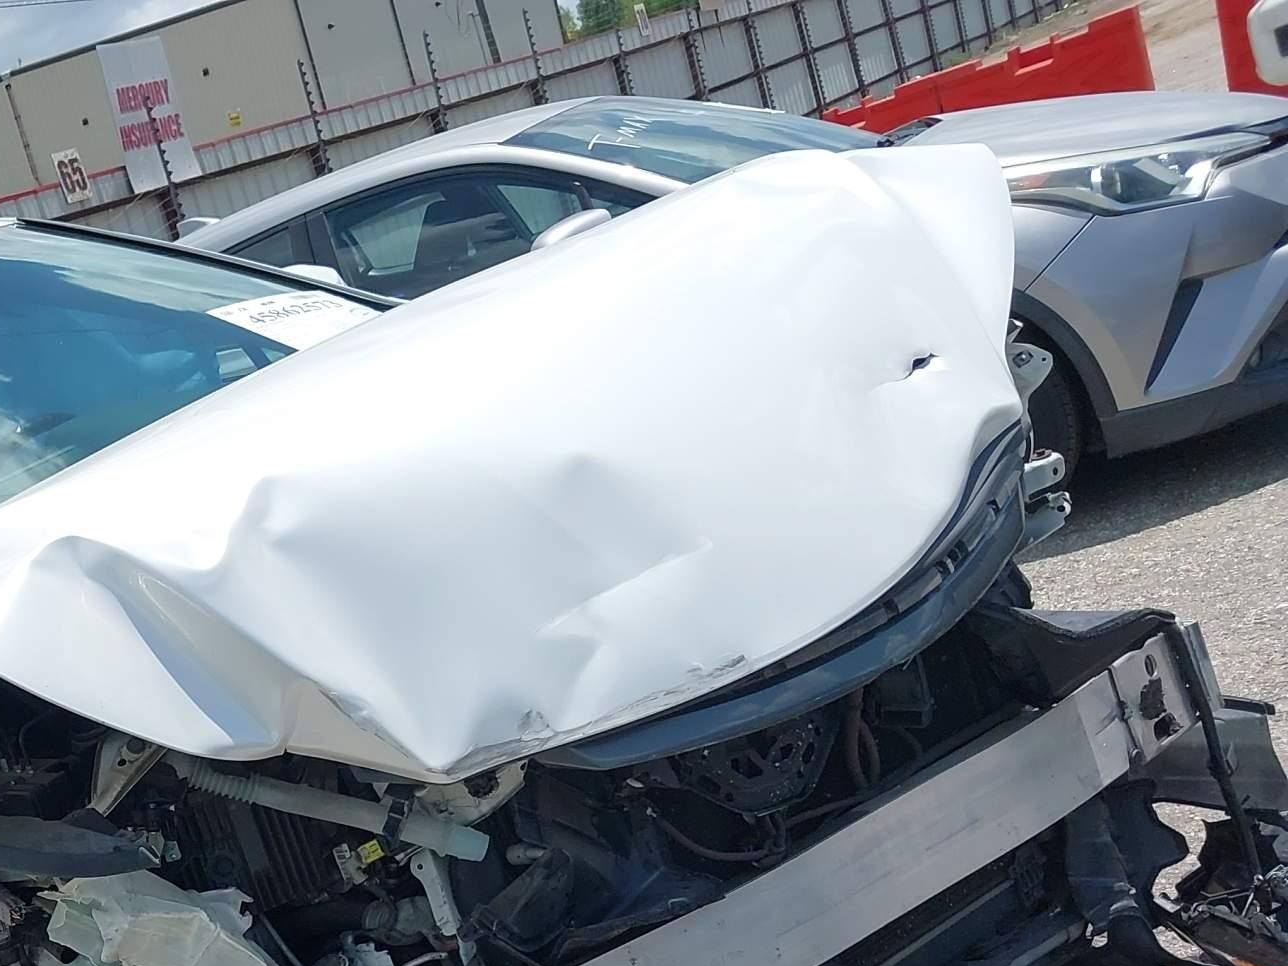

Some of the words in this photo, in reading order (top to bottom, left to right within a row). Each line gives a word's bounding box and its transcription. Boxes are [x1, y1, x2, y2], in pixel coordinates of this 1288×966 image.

[116, 79, 170, 114] MERCURY
[57, 157, 88, 193] 65
[249, 299, 343, 324] 45862573
